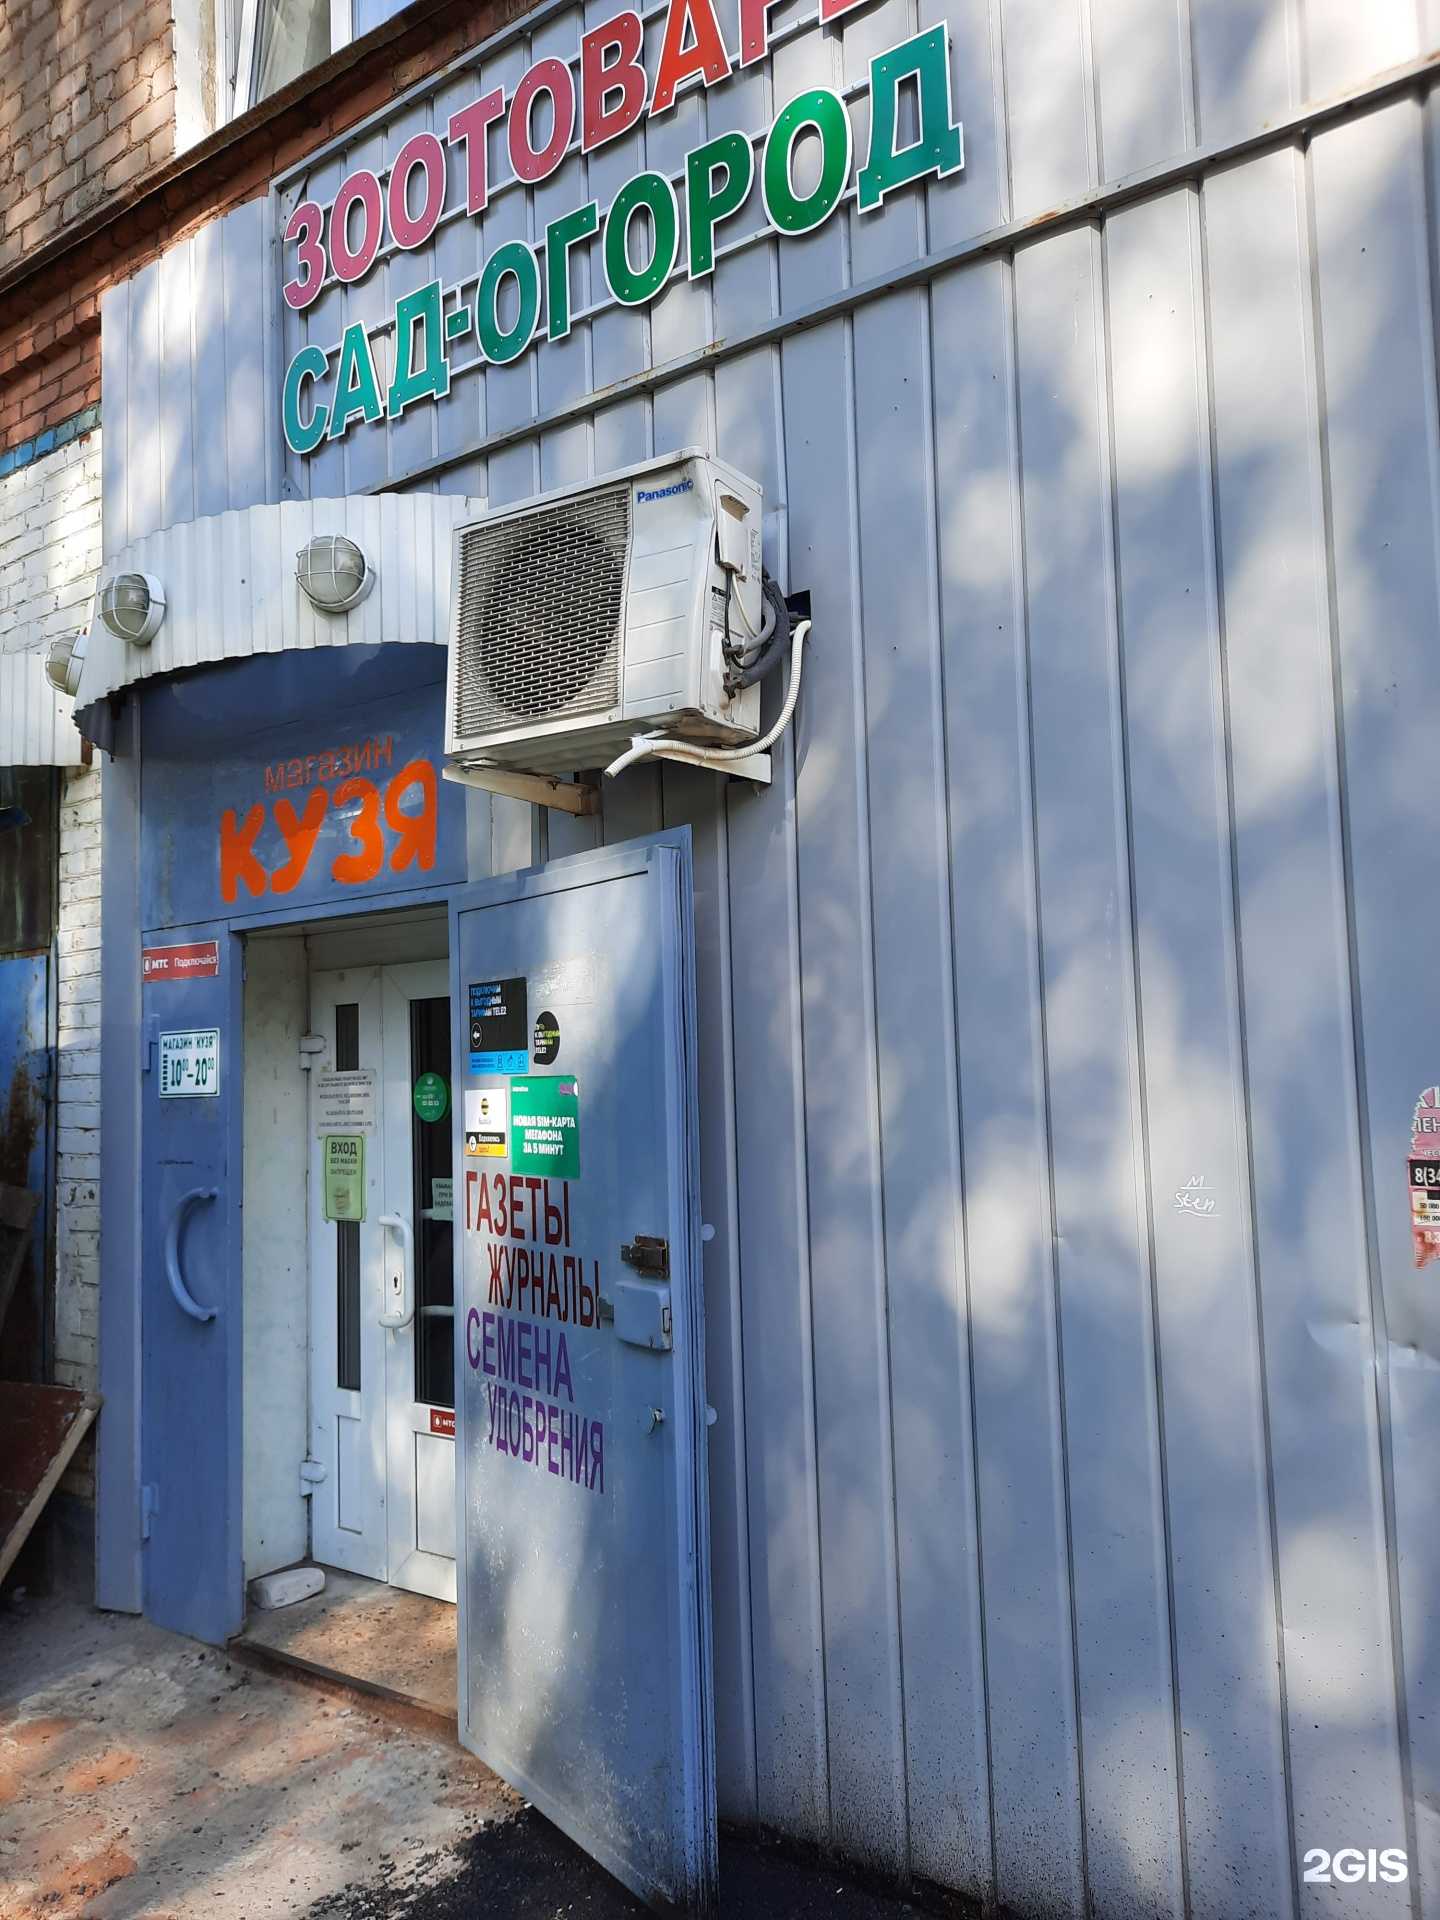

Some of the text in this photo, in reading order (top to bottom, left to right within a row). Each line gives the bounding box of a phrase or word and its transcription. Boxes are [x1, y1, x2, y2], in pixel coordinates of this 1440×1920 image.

[283, 0, 870, 310] ЗООТОВА
[283, 20, 966, 455] САД-ОГОРОД
[637, 478, 694, 503] Panasonic
[219, 759, 438, 904] КУЗЯ
[151, 958, 169, 969] МТС
[163, 1037, 193, 1049] МАГАЗИН
[512, 1115, 576, 1128] НОВАЯ SIM-КАРТА
[524, 1129, 563, 1142] МЕГАФОНА
[331, 1141, 358, 1157] ВХОД
[538, 1143, 564, 1156] МИНУТ
[465, 1170, 570, 1248] ГАЗЕТЫ
[487, 1243, 601, 1330] ЖУРНАЛЫ
[466, 1307, 574, 1402] СЕМЕНА
[488, 1381, 604, 1494] УДОБРЕНИЯ
